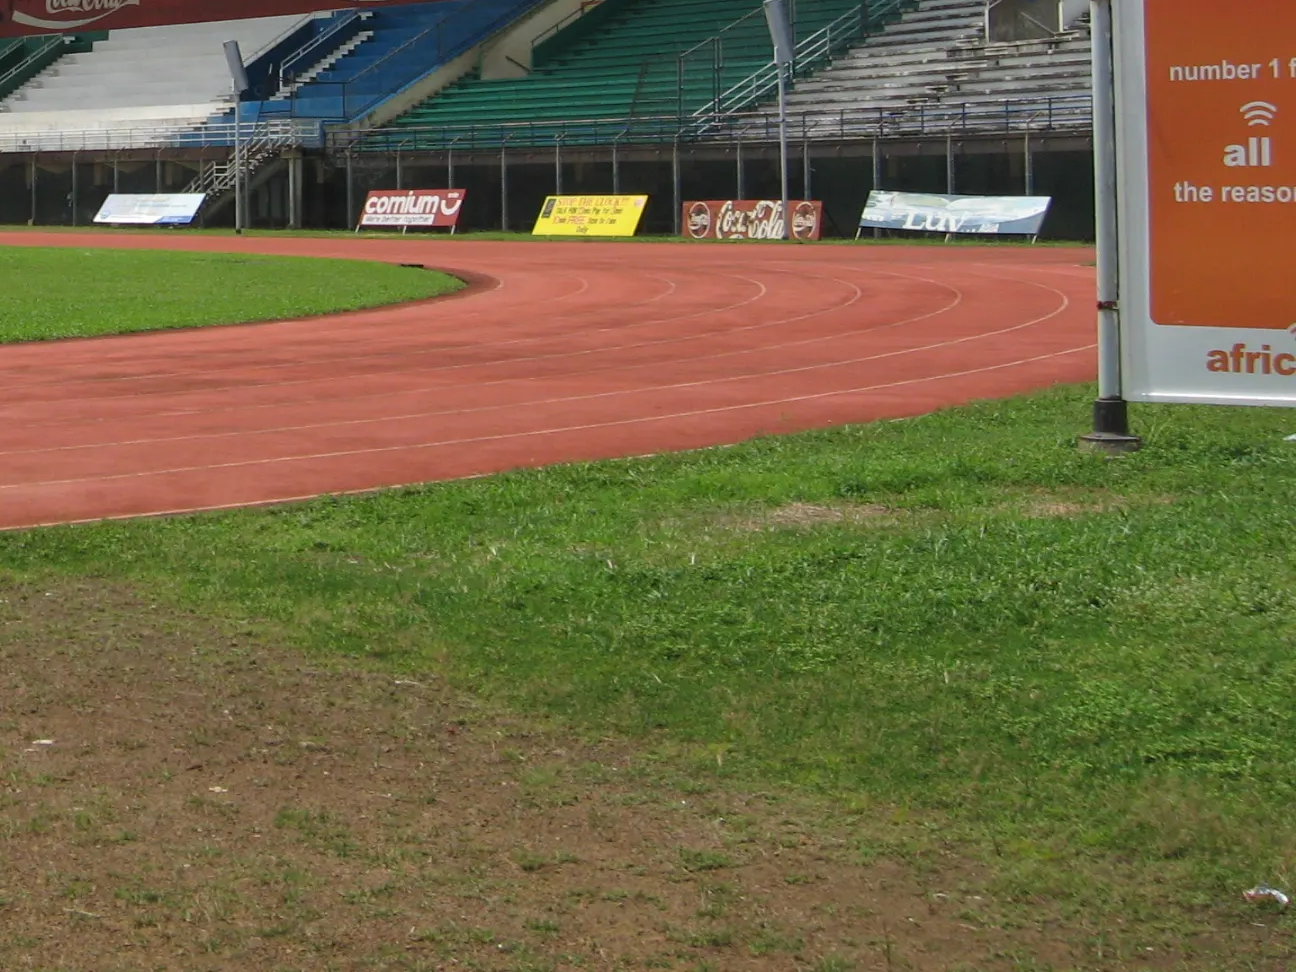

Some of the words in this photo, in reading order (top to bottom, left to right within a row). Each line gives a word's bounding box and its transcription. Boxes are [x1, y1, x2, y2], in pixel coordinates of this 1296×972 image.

[1169, 59, 1262, 81] number
[1268, 58, 1280, 79] 1
[1223, 136, 1271, 167] all
[364, 190, 440, 215] comium
[1173, 180, 1213, 203] the
[1206, 342, 1296, 376] afric
